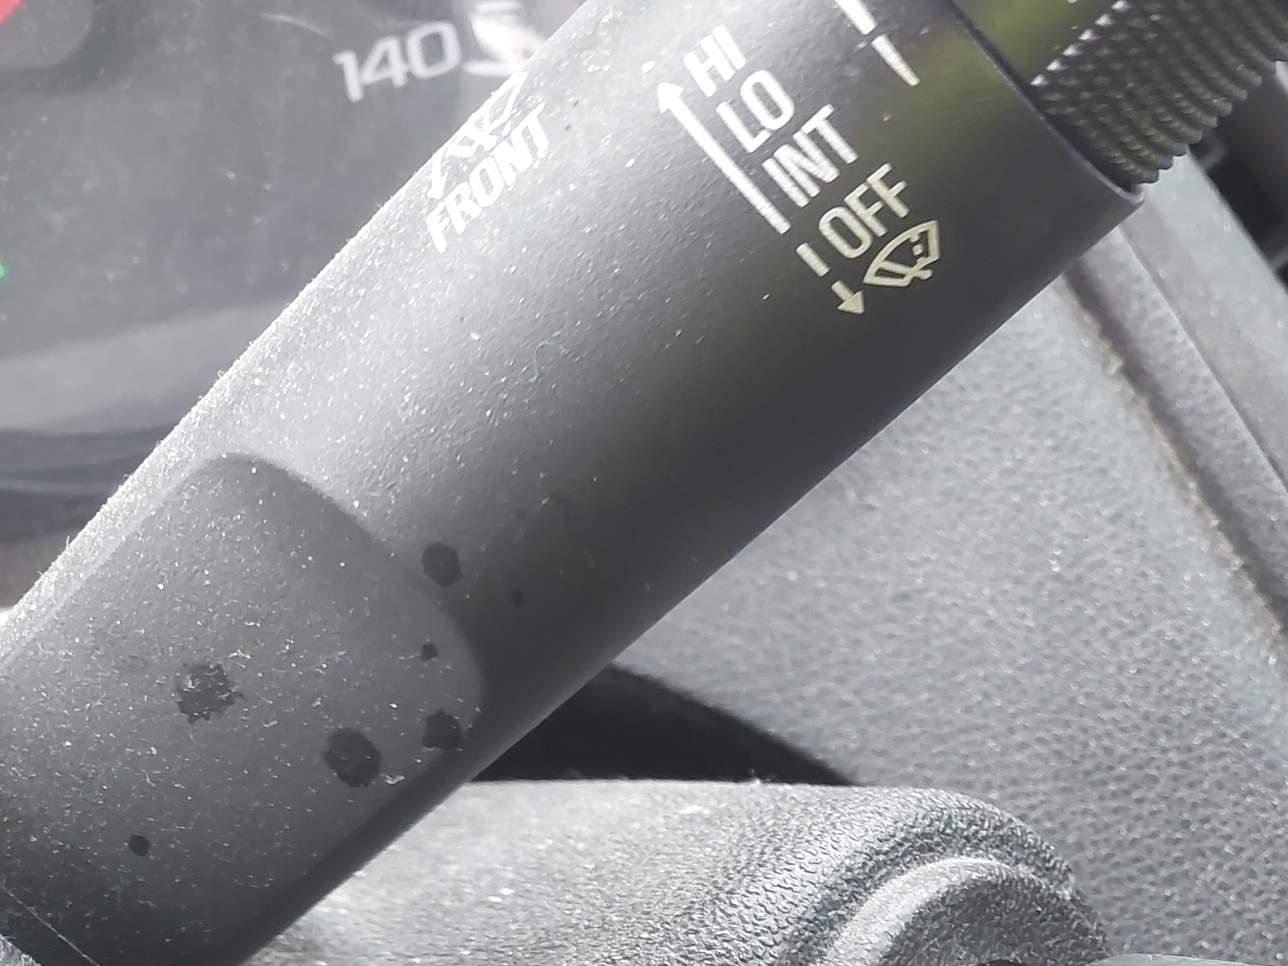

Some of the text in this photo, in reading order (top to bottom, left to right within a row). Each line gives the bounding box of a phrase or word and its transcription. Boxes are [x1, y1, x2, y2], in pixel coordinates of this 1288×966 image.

[332, 21, 461, 102] 140
[682, 23, 747, 98] HI
[715, 69, 795, 153] LO
[761, 103, 858, 208] INT
[425, 101, 549, 254] FRONT
[818, 162, 909, 259] OFF
